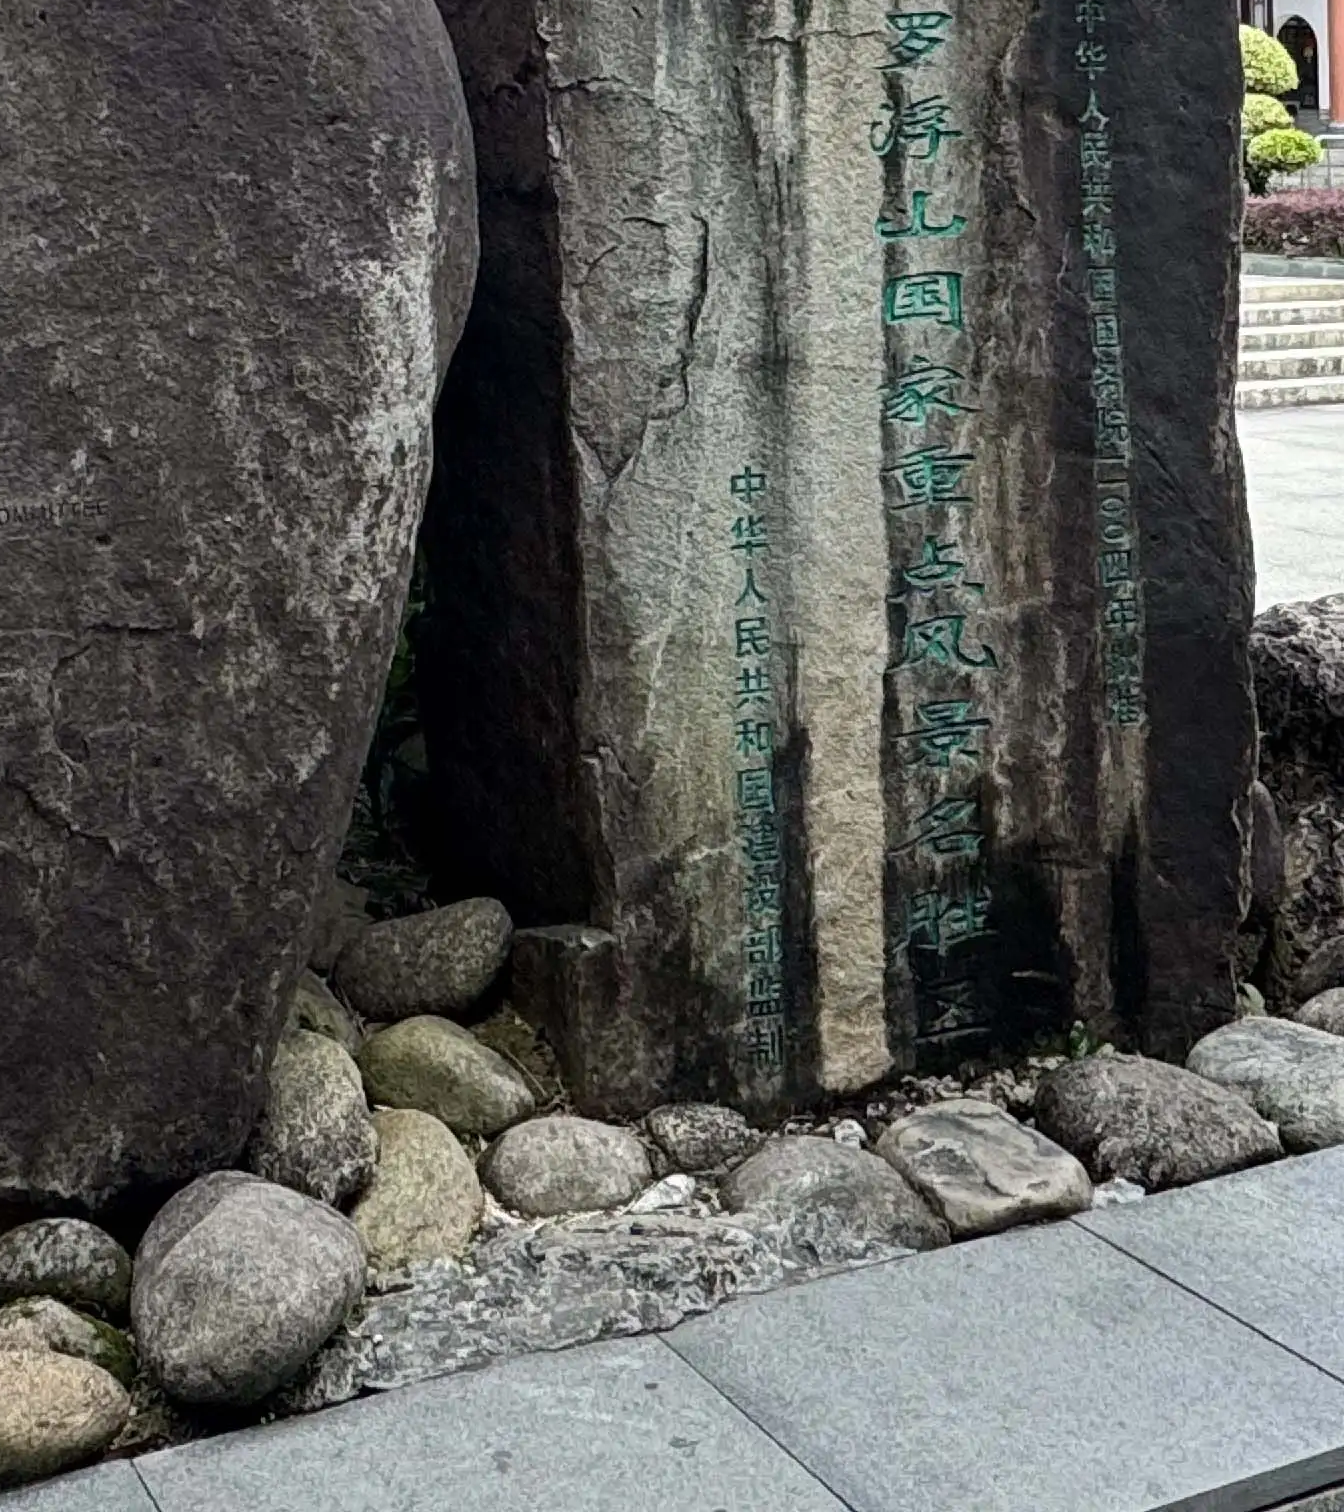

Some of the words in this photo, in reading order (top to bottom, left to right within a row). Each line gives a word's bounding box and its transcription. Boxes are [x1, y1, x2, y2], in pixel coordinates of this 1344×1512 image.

[869, 9, 998, 1045] 罗浮山国家重点风景名胜区
